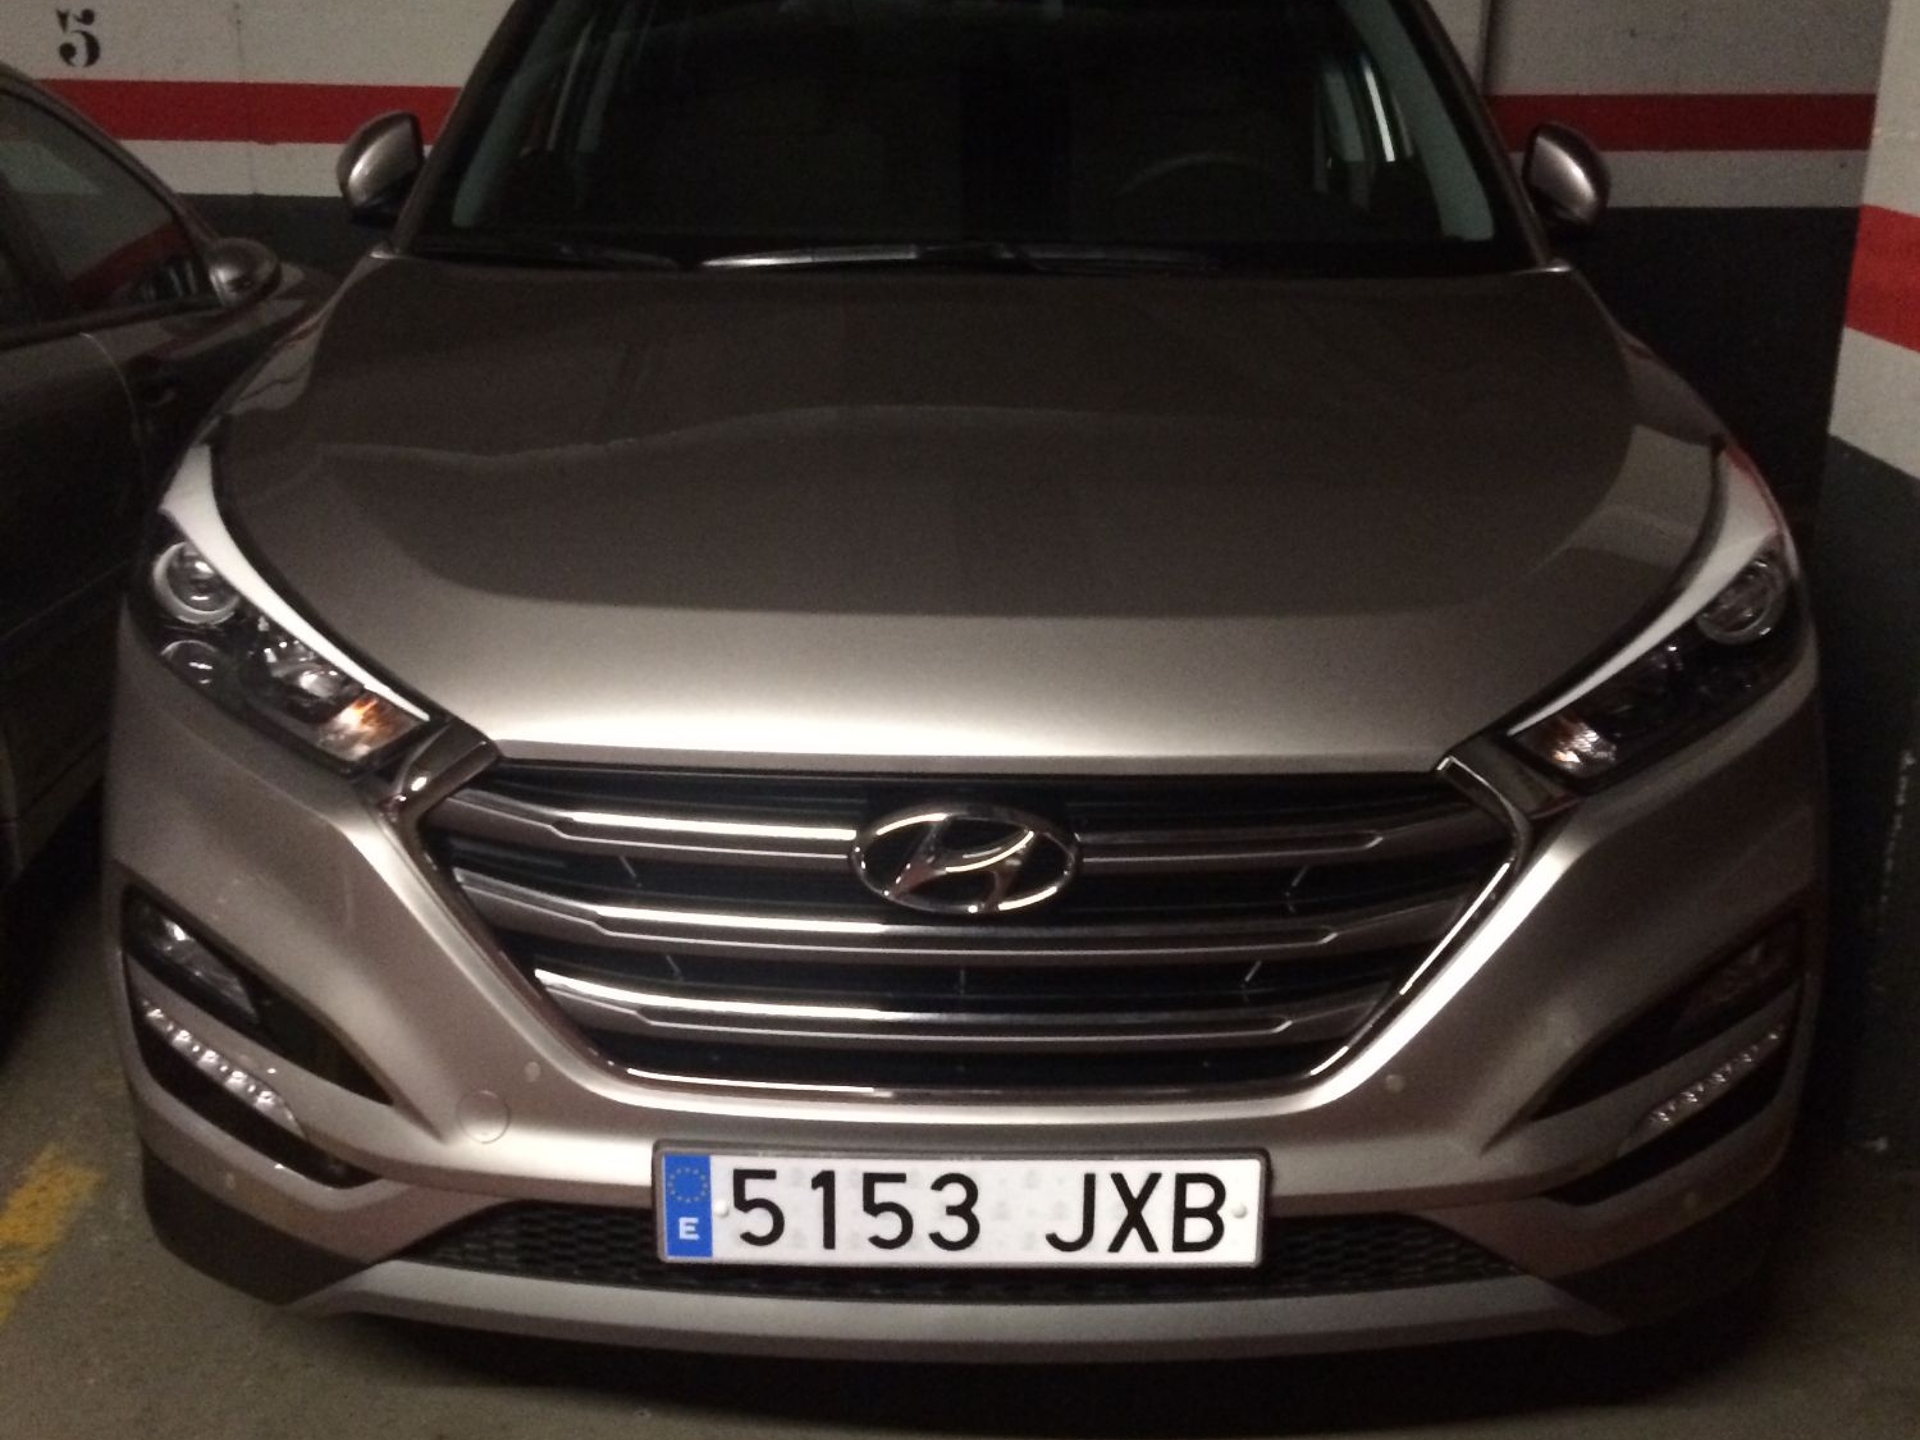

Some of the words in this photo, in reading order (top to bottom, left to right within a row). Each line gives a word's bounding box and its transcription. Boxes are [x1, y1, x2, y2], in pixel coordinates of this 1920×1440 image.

[56, 8, 101, 68] 5
[678, 1217, 700, 1240] E
[732, 1168, 981, 1252] 5153
[1045, 1172, 1227, 1253] JXB
